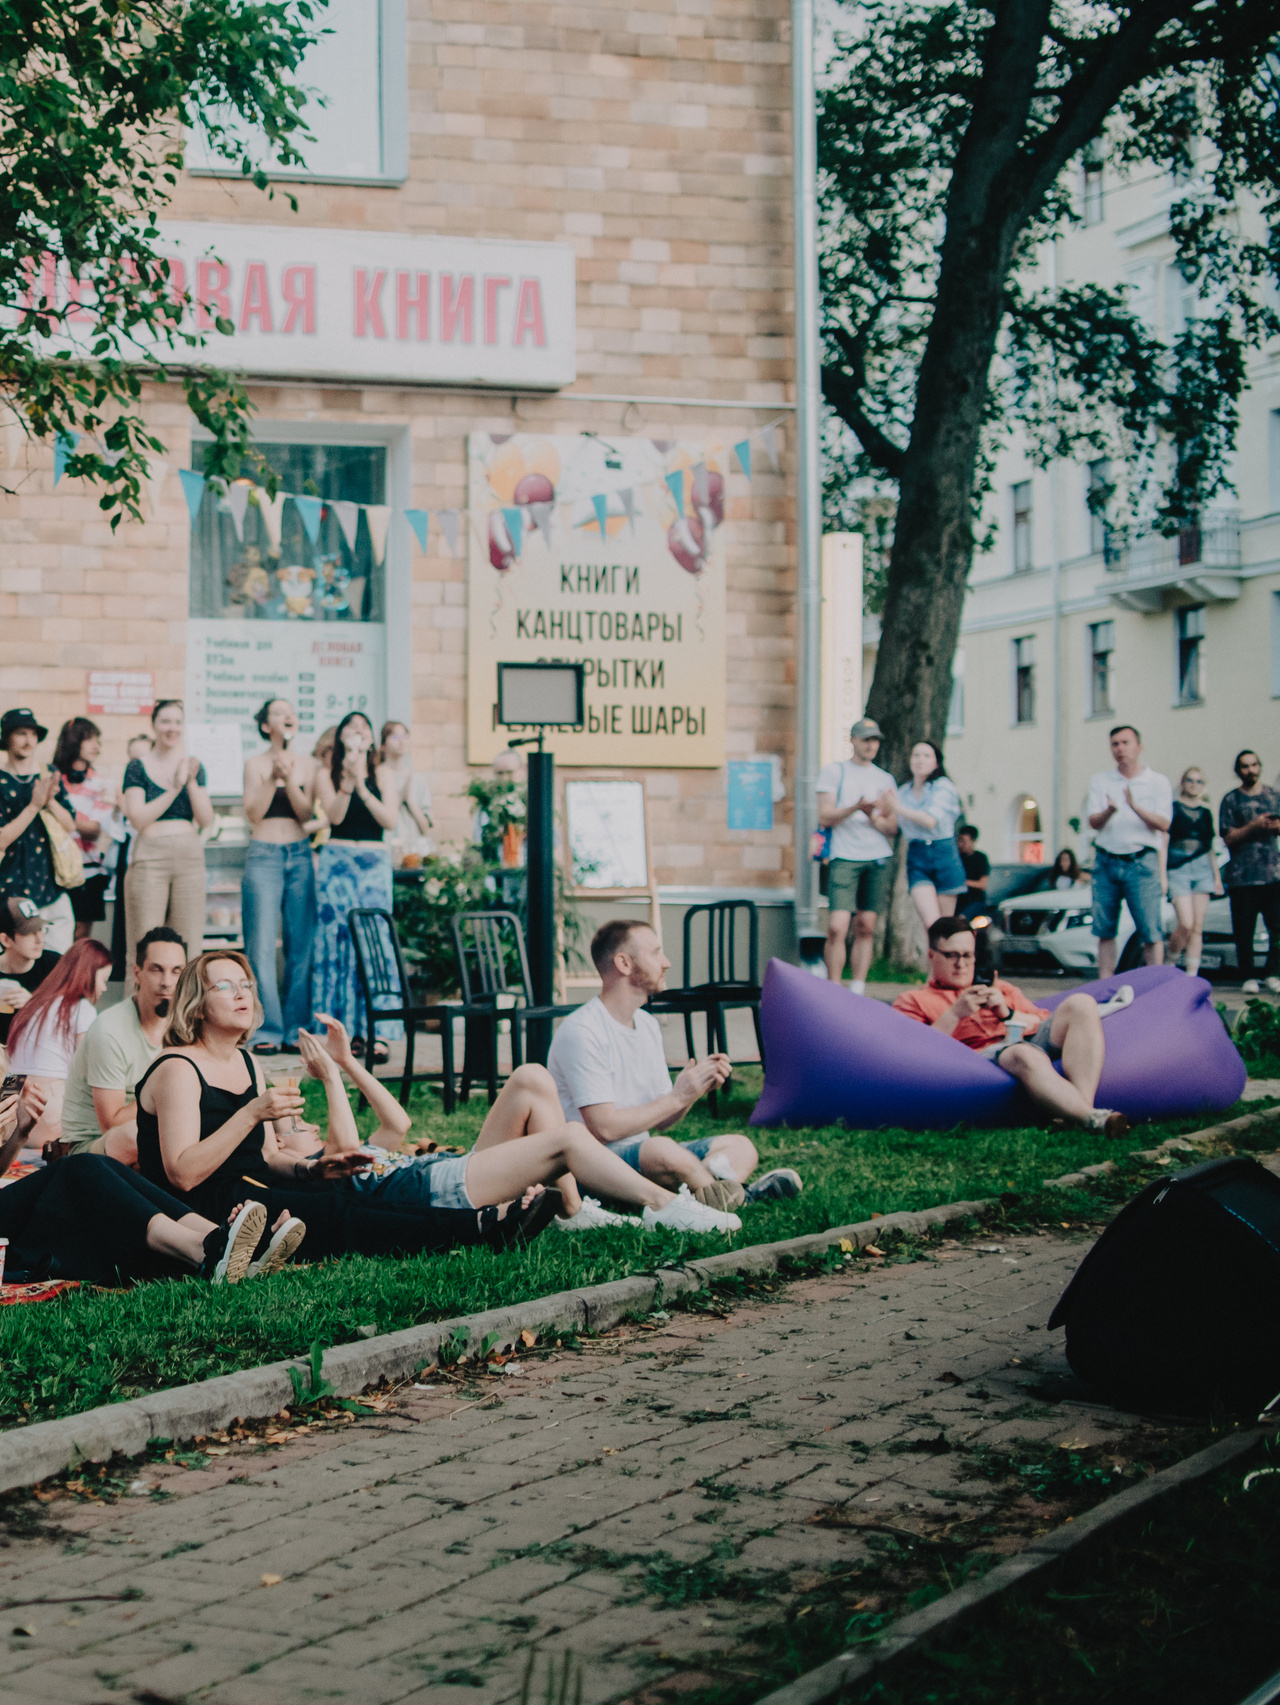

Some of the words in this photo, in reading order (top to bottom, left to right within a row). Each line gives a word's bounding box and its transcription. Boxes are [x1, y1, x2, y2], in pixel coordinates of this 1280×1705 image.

[354, 269, 547, 347] КНИГА
[560, 564, 640, 594] КНИГИ
[517, 609, 683, 643] КАНЦТОВАРЫ
[537, 657, 665, 689] РЫТКИ
[631, 705, 706, 736] ШАРЫ
